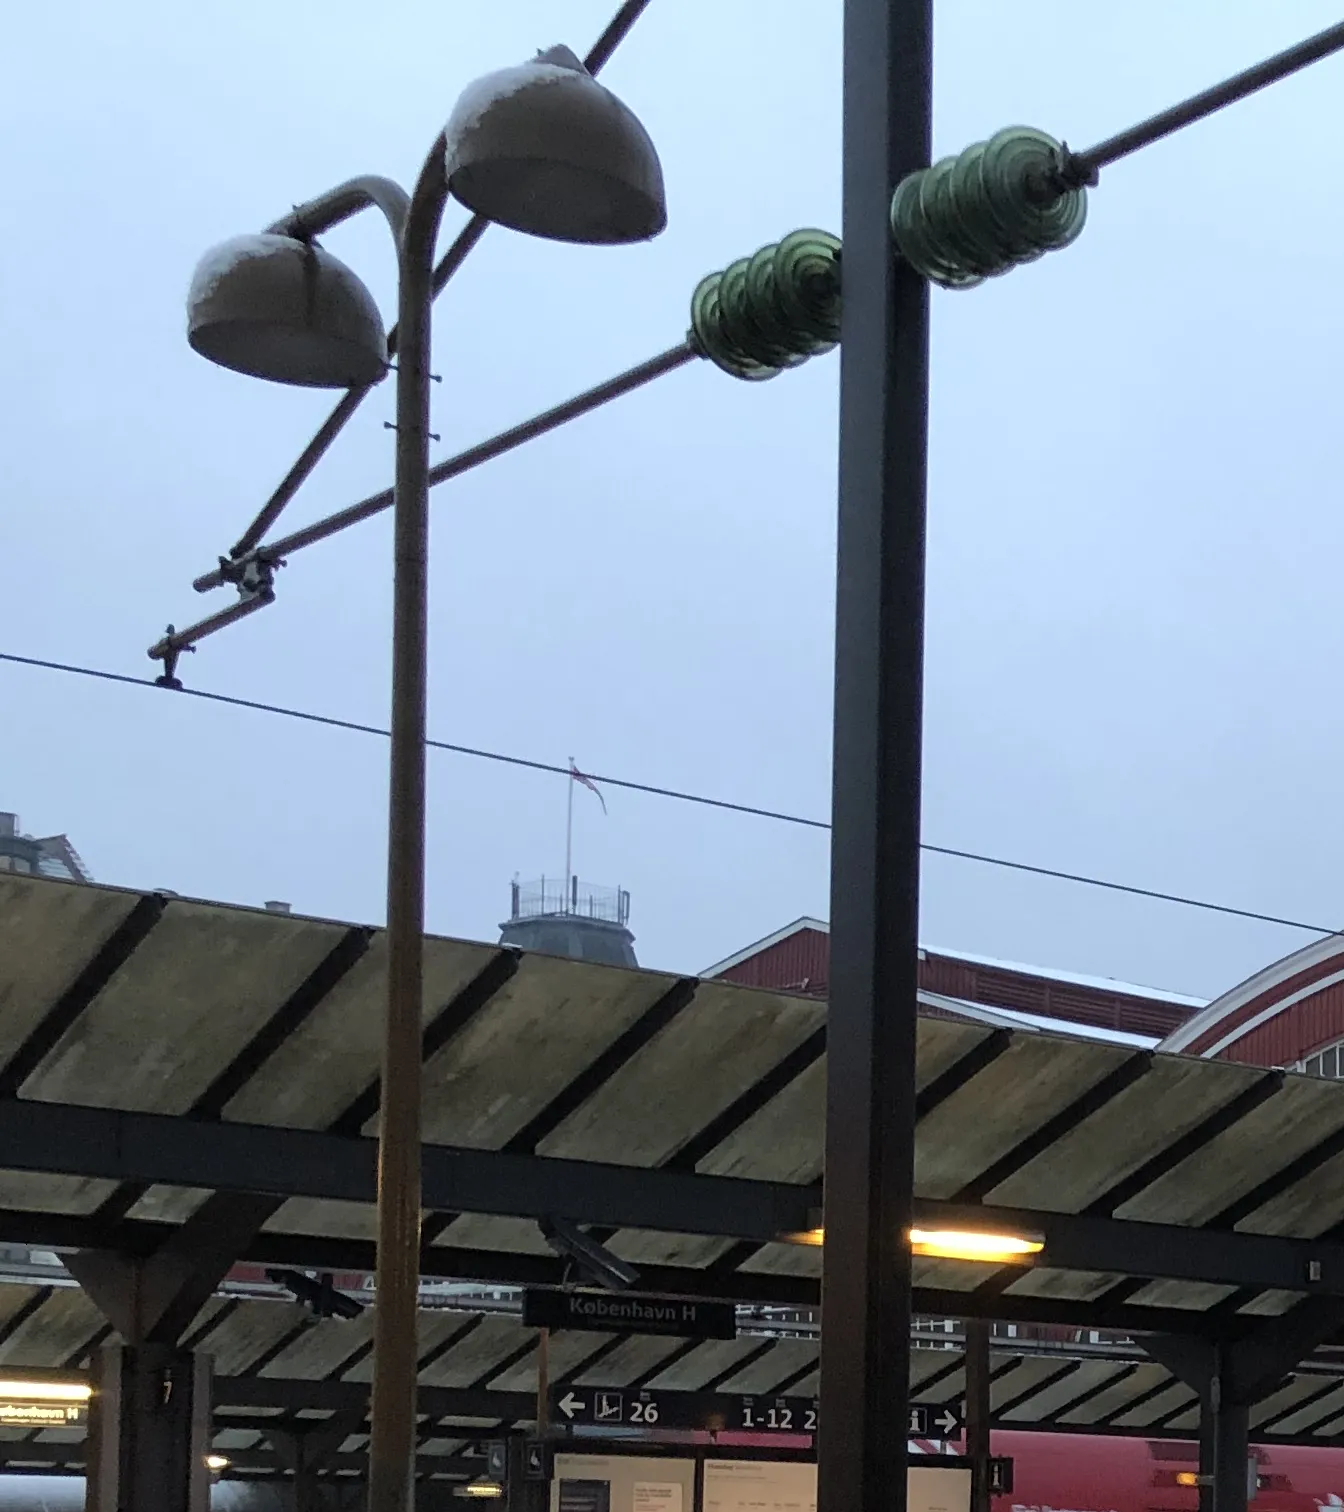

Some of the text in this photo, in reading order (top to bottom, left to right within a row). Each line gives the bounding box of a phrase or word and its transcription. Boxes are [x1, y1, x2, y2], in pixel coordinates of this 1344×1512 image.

[569, 1297, 697, 1322] København H
[163, 1381, 173, 1404] 7
[67, 1407, 79, 1420] H
[629, 1402, 659, 1423] 26
[742, 1408, 818, 1430] 1-12 2
